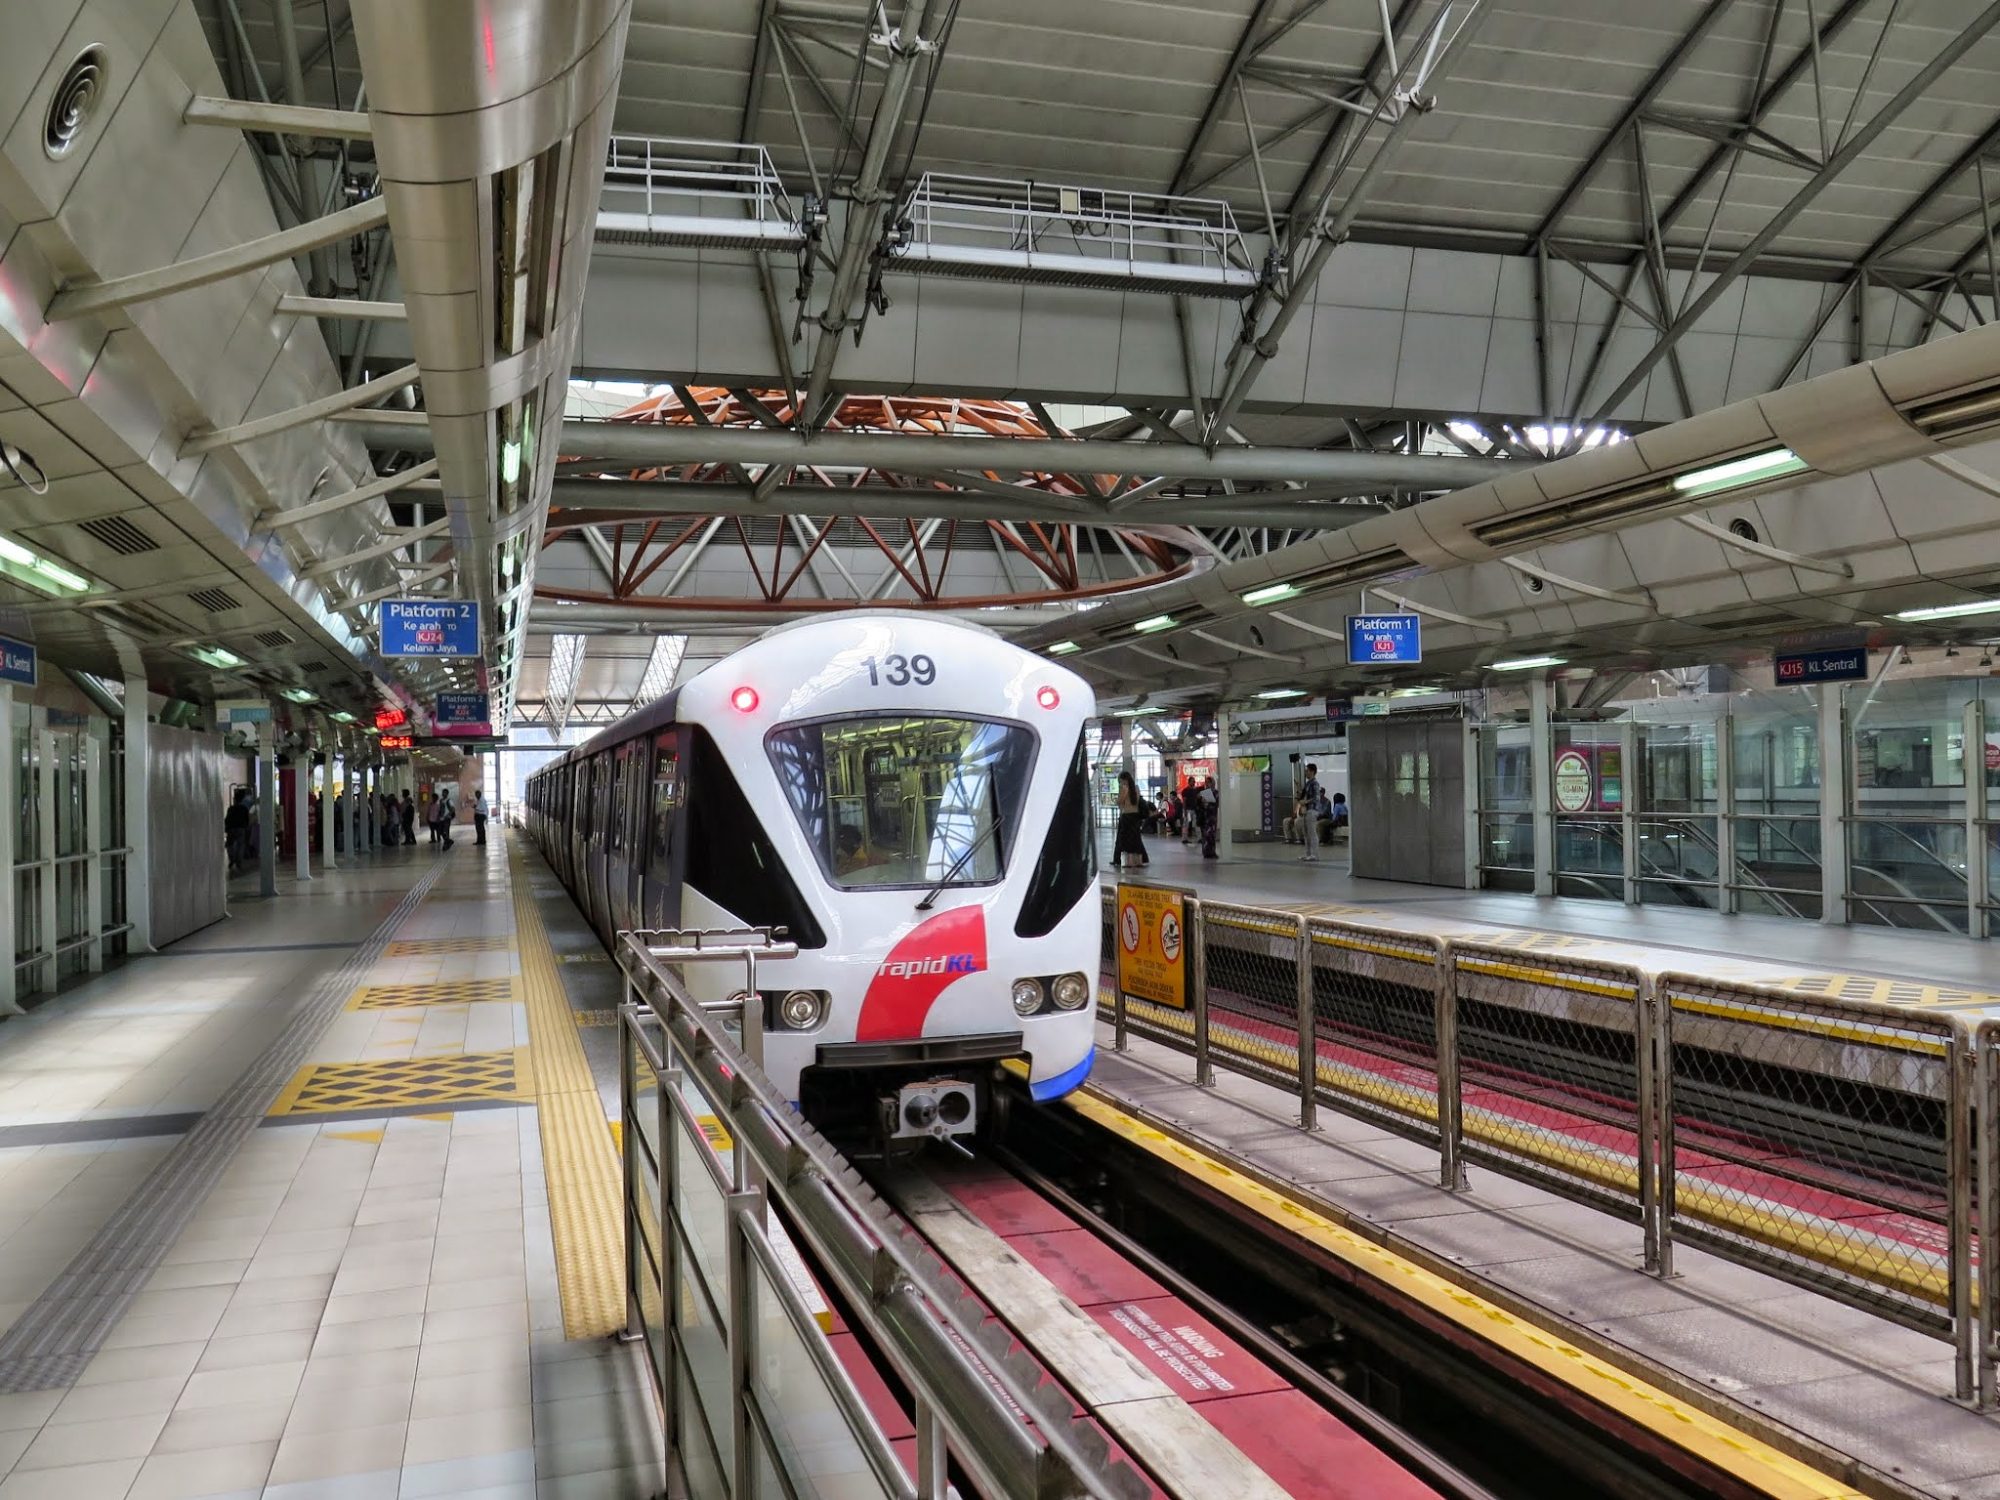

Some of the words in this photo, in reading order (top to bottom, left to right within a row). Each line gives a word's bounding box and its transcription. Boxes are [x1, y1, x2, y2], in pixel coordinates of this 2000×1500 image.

[390, 604, 455, 617] Platform
[460, 605, 470, 618] 2
[403, 621, 417, 630] Ke
[419, 621, 441, 630] arah
[1354, 619, 1401, 630] Platform
[1405, 619, 1411, 629] 1
[417, 632, 442, 642] KJ24
[1364, 633, 1374, 641] Ke
[1376, 632, 1392, 641] arah
[403, 643, 433, 653] Kelana
[436, 643, 457, 655] Jaya
[1377, 642, 1391, 650] KJ1
[1370, 652, 1398, 660] Gombak
[860, 654, 936, 686] 139
[1780, 663, 1803, 676] KJ15
[1808, 660, 1821, 673] KL
[1823, 657, 1857, 672] Sentral
[441, 695, 476, 703] Platform
[478, 695, 484, 703] 2
[878, 954, 977, 979] rapidKL
[1172, 1326, 1225, 1358] WARNING
[1165, 1357, 1211, 1390] PROSECUTED
[1192, 1359, 1235, 1391] PROHIBITED
